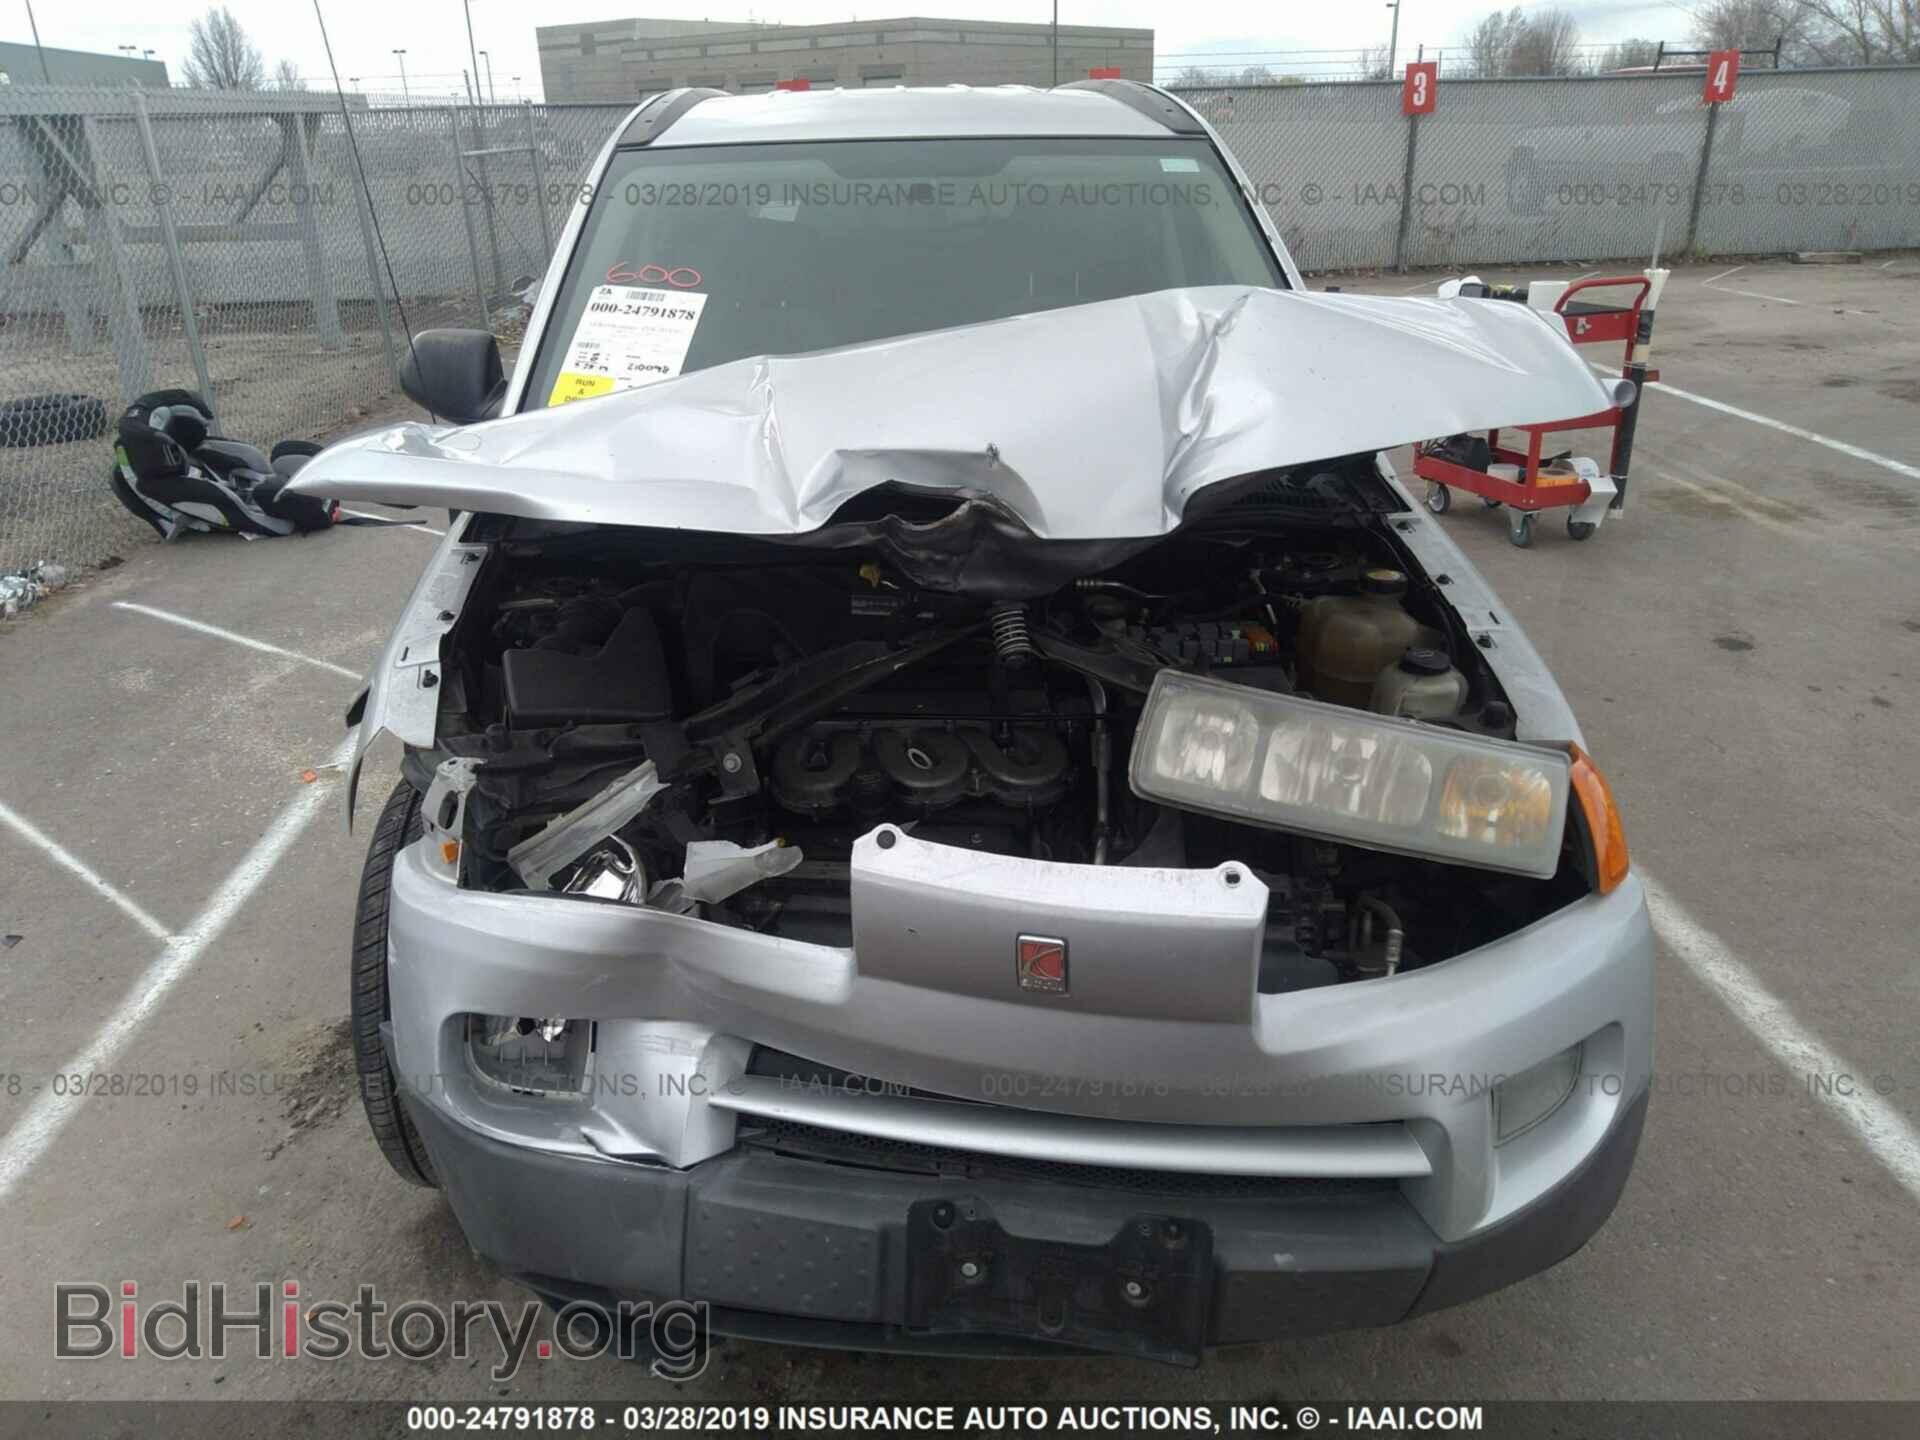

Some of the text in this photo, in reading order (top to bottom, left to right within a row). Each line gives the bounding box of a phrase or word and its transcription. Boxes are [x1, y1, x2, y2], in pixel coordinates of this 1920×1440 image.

[1413, 72, 1426, 106] 3
[1713, 60, 1728, 93] 4
[607, 261, 703, 288] 600
[590, 302, 695, 321] 000-24791878
[576, 378, 596, 387] RUN
